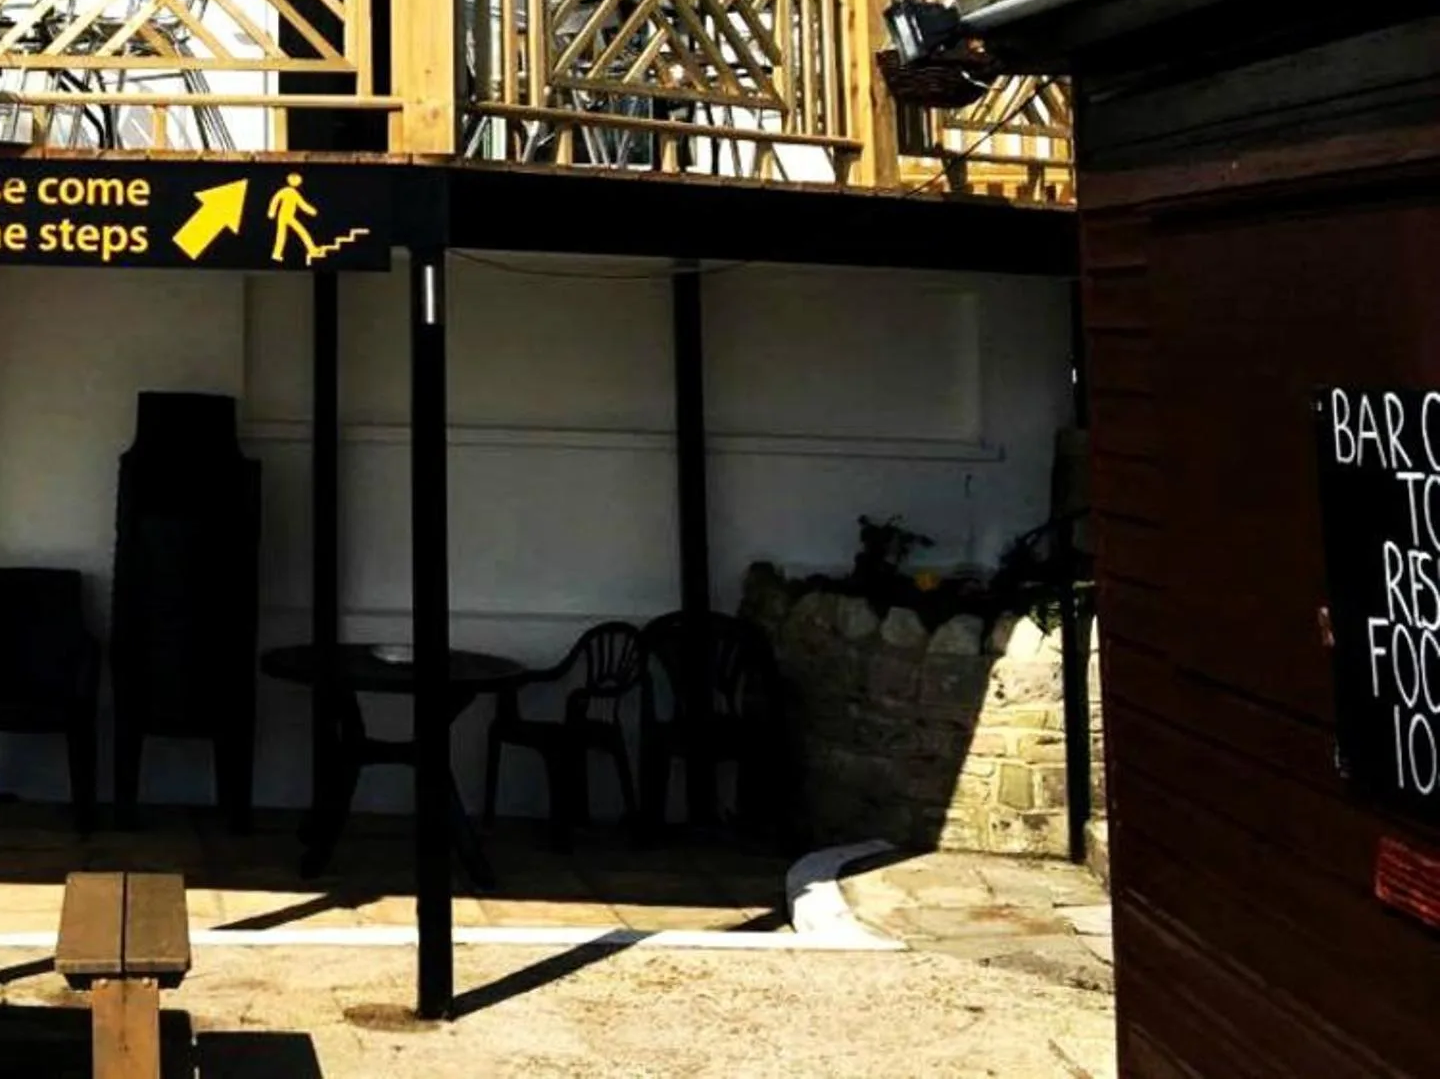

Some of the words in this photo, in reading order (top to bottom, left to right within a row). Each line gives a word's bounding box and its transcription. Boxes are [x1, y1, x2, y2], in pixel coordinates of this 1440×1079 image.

[38, 178, 150, 206] come
[39, 219, 148, 261] steps
[1332, 387, 1413, 469] BAR
[1383, 540, 1440, 630] RES
